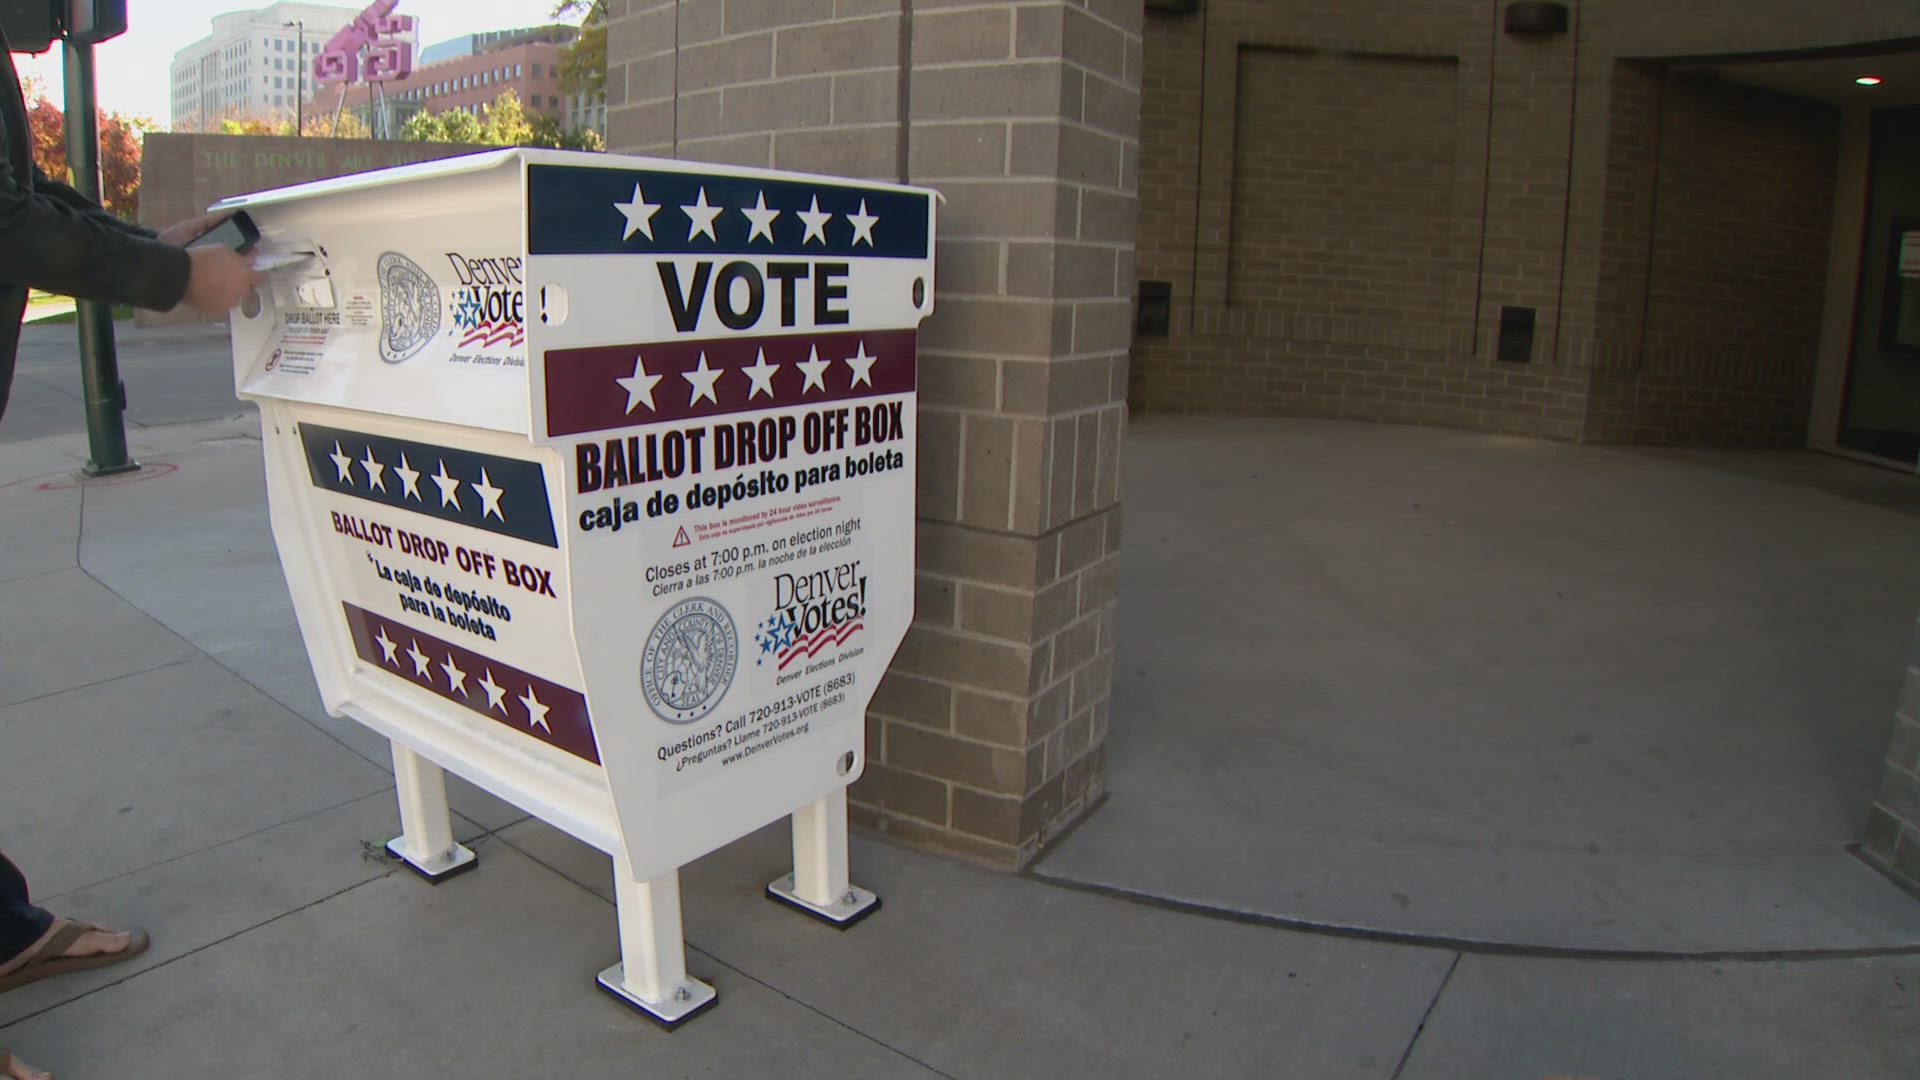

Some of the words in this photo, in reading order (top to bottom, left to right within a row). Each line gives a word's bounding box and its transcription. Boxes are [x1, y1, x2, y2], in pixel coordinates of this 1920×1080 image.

[206, 152, 237, 168] THE
[254, 152, 327, 168] DENVER
[344, 153, 372, 168] ART
[285, 312, 301, 325] DROP
[302, 312, 323, 325] BALLOT
[325, 312, 341, 325] HERE
[656, 261, 849, 332] VOTE
[449, 353, 471, 363] Denver
[473, 354, 501, 366] Elections
[503, 356, 525, 367] Divisio
[576, 427, 706, 494] BALLOT
[714, 416, 797, 470] DROP
[803, 408, 849, 455] OFF
[855, 401, 904, 447] BOX
[579, 497, 639, 532] caja
[646, 491, 679, 518] de
[686, 473, 789, 510] depósito
[795, 462, 841, 494] para
[845, 449, 904, 479] boleta
[694, 524, 708, 533] This
[709, 521, 721, 530] box
[722, 519, 728, 528] is
[729, 512, 760, 527] monitored
[761, 510, 768, 520] by
[769, 508, 777, 517] 24
[779, 506, 791, 515] hour
[792, 502, 807, 512] video
[331, 511, 393, 549] BALLOT
[397, 529, 450, 565] DROP
[455, 546, 497, 580] OFF
[502, 558, 557, 598] BOX
[645, 559, 690, 583] Closes
[694, 554, 707, 572] at
[711, 548, 739, 568] 7:00
[743, 541, 769, 563] p.m.
[772, 537, 786, 551] on
[789, 526, 832, 547] election
[835, 518, 861, 538] night
[652, 578, 684, 597] Cierra
[686, 578, 693, 588] a
[695, 571, 710, 586] las
[713, 565, 734, 582] 7:00
[735, 561, 755, 577] p.m.
[758, 556, 766, 569] la
[768, 550, 795, 567] noche
[796, 546, 807, 559] de
[809, 543, 817, 556] la
[818, 535, 851, 554] elección
[375, 559, 393, 582] La
[395, 568, 422, 593] caja
[424, 576, 442, 599] de
[445, 583, 511, 622] depósito
[774, 559, 860, 612] Denver
[786, 575, 867, 639] Votes!
[399, 593, 430, 617] para
[432, 600, 446, 623] la
[447, 606, 497, 641] boleta
[654, 617, 672, 641] THE
[672, 602, 705, 619] CLERK
[707, 605, 727, 624] AND
[646, 646, 656, 663] OF
[660, 631, 677, 655] AND
[722, 622, 736, 686] RECORDER
[644, 667, 661, 706] OFFICE
[656, 657, 665, 682] CITY
[776, 669, 802, 686] Denver
[805, 658, 835, 677] Elections
[838, 646, 864, 666] Division
[657, 723, 723, 761] Questions?
[725, 714, 746, 734] Call
[749, 684, 821, 724] 720-913-VOTE
[823, 671, 856, 698] (8683)
[682, 694, 700, 706] SEAL
[675, 738, 732, 772] ¿Preguntas?
[734, 728, 760, 746] Llame
[763, 701, 818, 734] 720-913-VOTE
[819, 692, 846, 712] (8683)
[721, 722, 809, 767] www.DenverVotes.org
